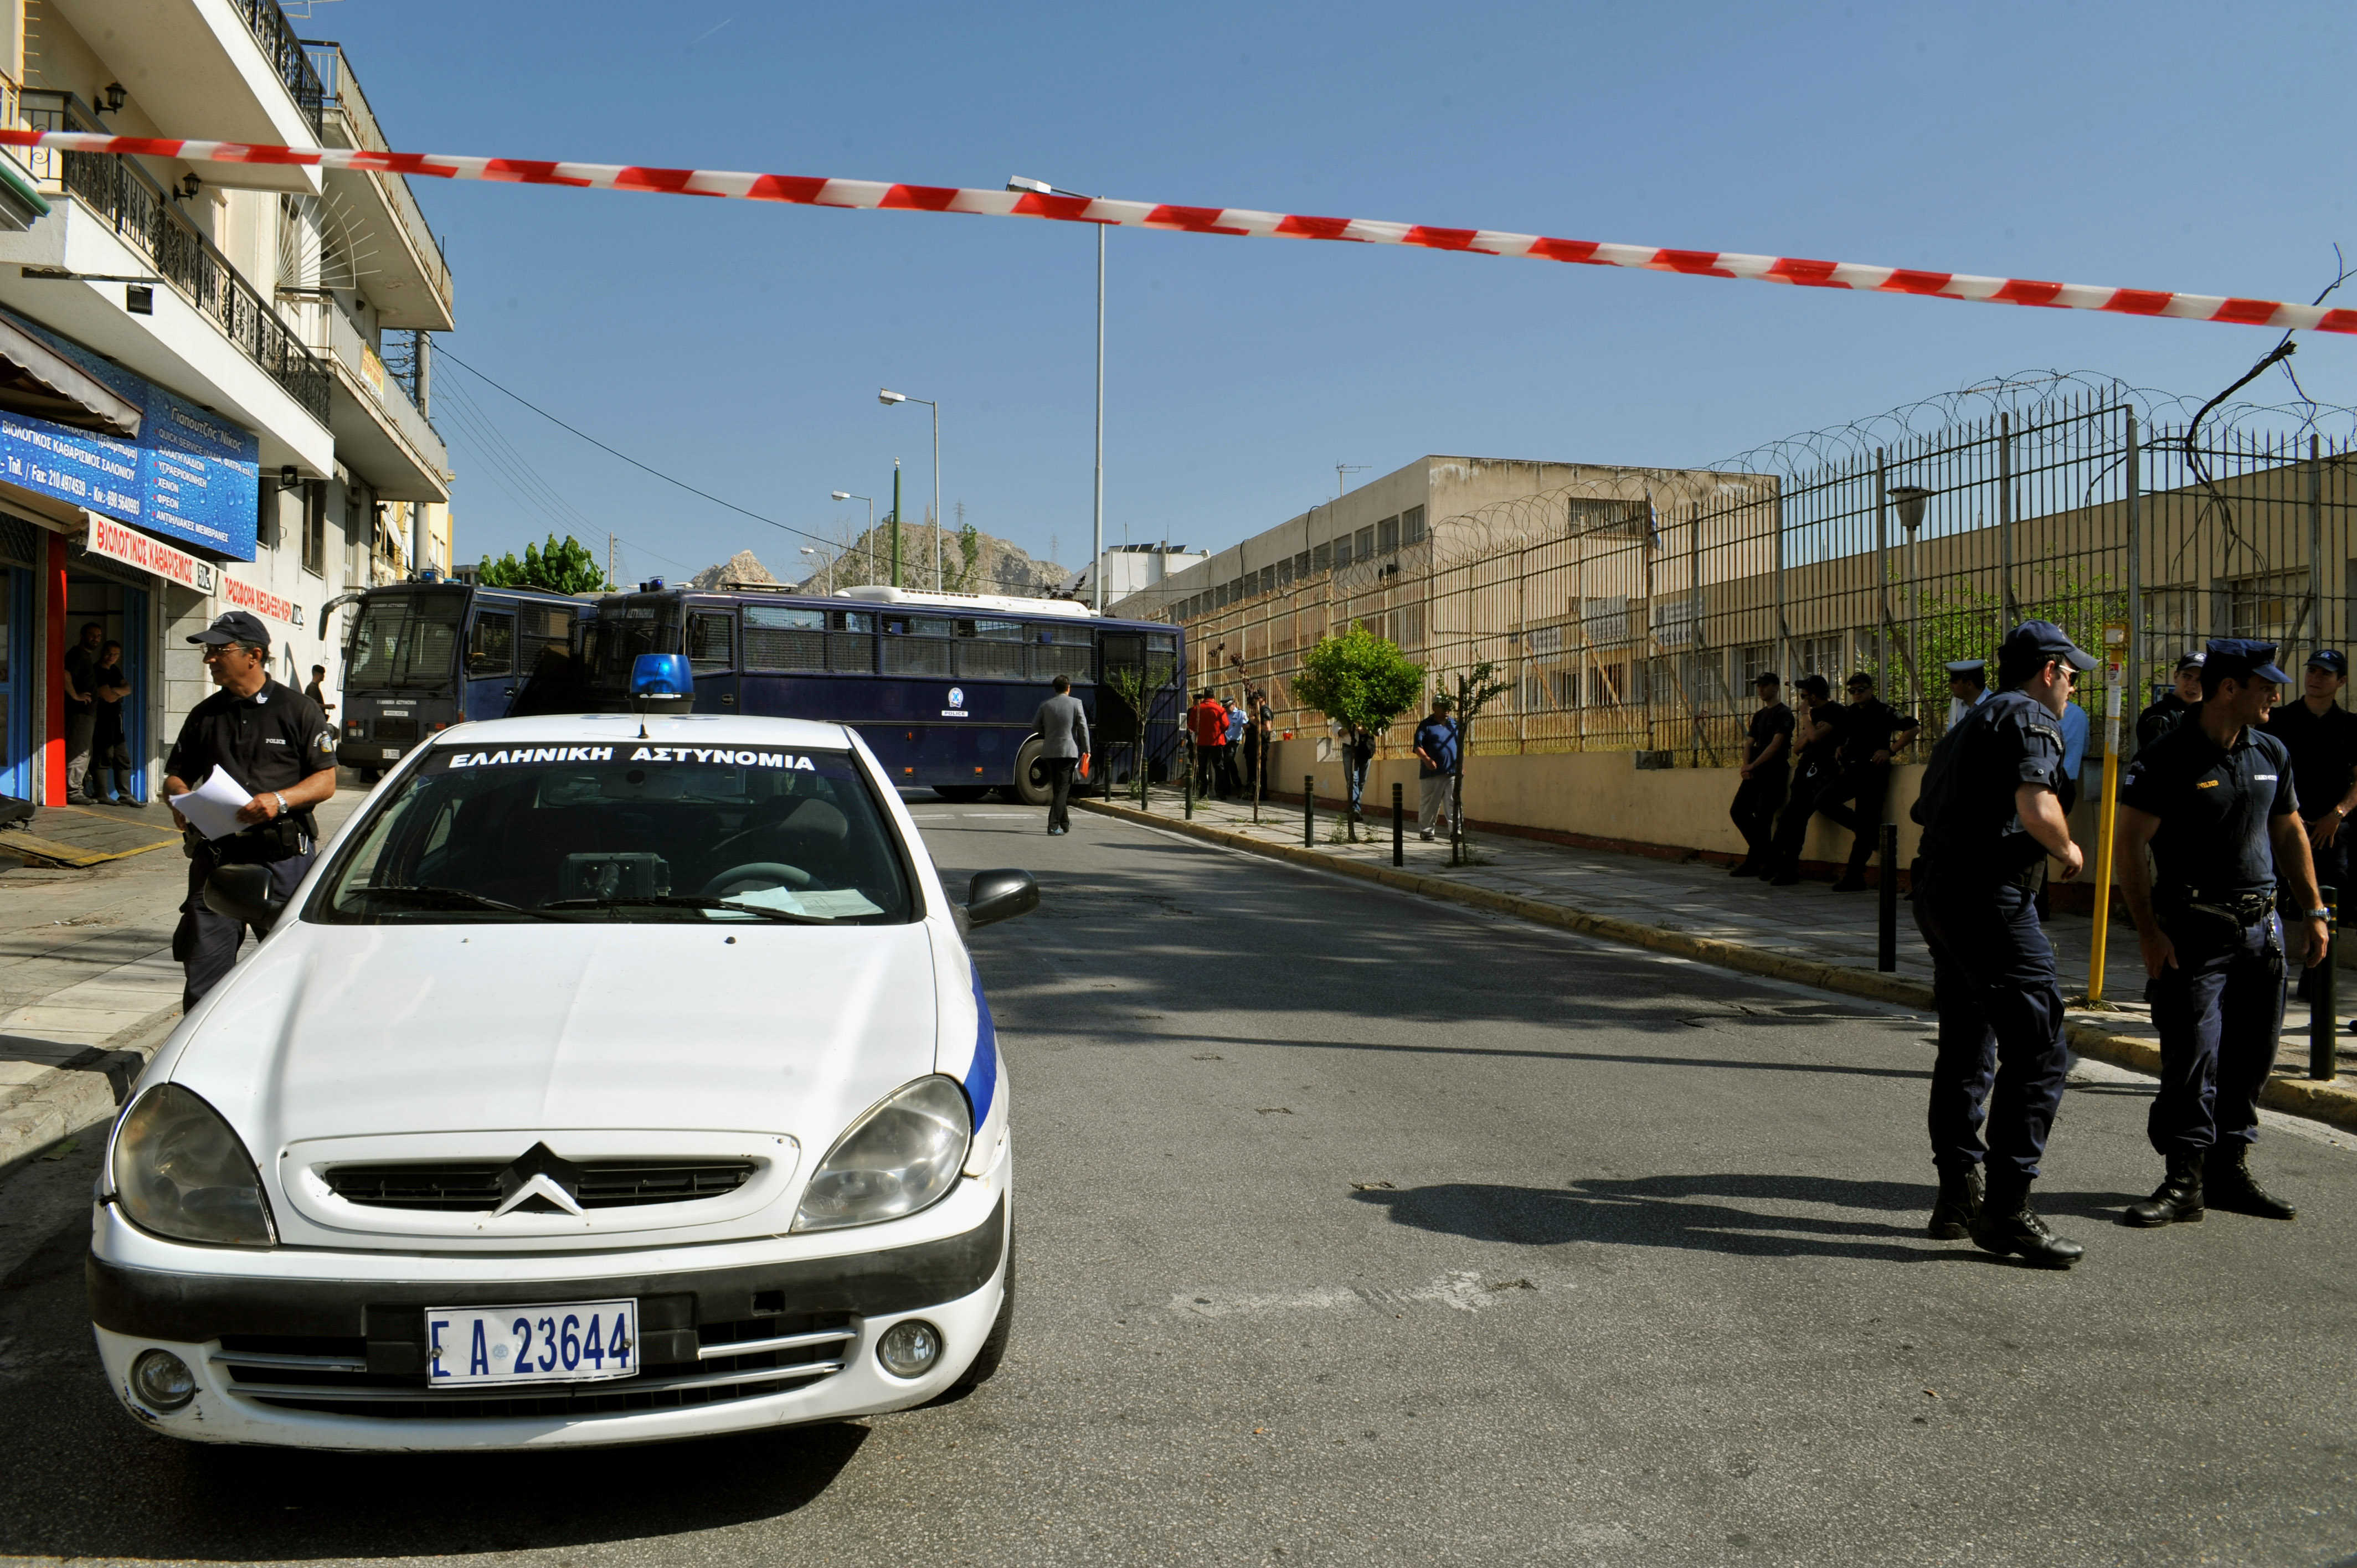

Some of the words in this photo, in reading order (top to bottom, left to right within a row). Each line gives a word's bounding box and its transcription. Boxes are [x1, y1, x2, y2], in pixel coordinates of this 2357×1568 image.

[2, 420, 52, 450] ΒΙΟΛΟΓΙΚΟΣ
[53, 440, 101, 469] ΚΑΘΑΡΙΣΜΟΣ
[101, 459, 136, 481] ΣΑΛΟΝΙΟΥ
[158, 445, 184, 463] ΑΛΛΑΓΗ
[184, 454, 205, 472] ΛΑΔΙΩΝ
[159, 429, 178, 445] QUICK
[179, 437, 203, 455] SERVICE
[32, 465, 47, 484] Fax:
[48, 470, 60, 488] 210
[61, 474, 86, 497] 4974539
[107, 490, 117, 508] 698
[118, 494, 140, 515] 5640993
[158, 460, 207, 489] ΥΓΡΑΕΡΙΟΚΙΝΗΣΗ
[157, 493, 179, 510] ΦΡΕΟΝ
[156, 510, 195, 532] ΑΝΤΙΗΛΙΑΚΕΣ
[195, 523, 229, 543] ΜΕΜΒΡΑΝΕΣ
[97, 520, 147, 566] ΒΙΟΛΟΓΙΚΟΣ
[149, 541, 192, 584] ΚΑΘΑΡΙΣΜΟΣ
[225, 577, 255, 610] ΠΡΟΣΦΟΡΑ
[449, 747, 613, 768] ΕΛΛΗΝΙΚΗ
[630, 747, 815, 771] ΑΣΤΥΝΟΜΙΑ
[512, 1312, 630, 1374] 23644
